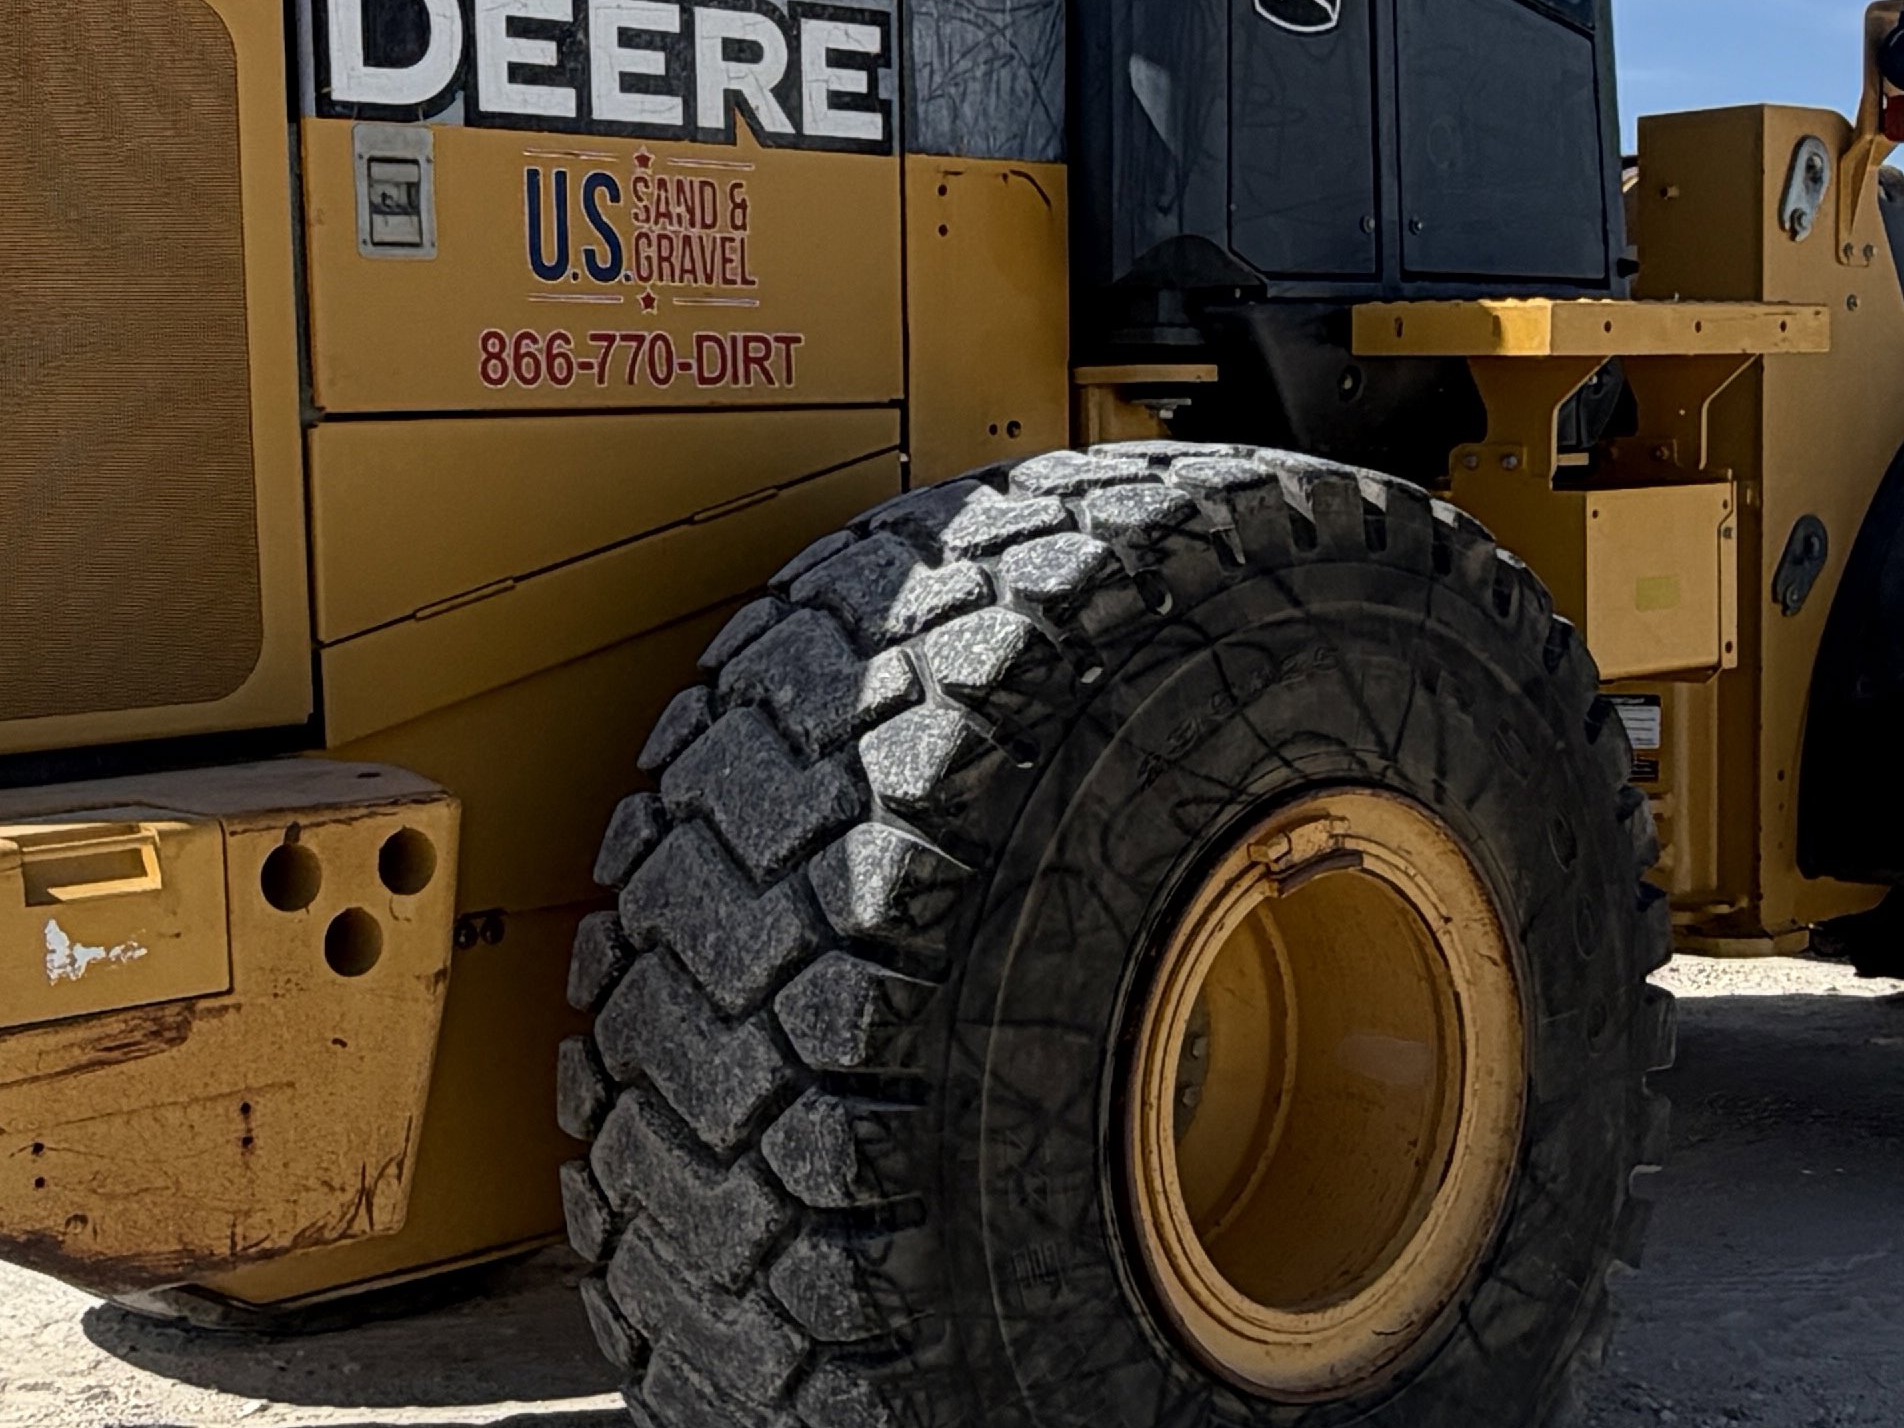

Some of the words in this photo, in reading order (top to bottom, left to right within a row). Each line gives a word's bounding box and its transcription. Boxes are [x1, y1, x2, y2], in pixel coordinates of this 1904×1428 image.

[525, 167, 632, 283] U.S.
[632, 175, 719, 231] SAND
[728, 181, 749, 231] &
[633, 231, 757, 286] GRAVEL
[479, 329, 804, 387] 866-770-DIRT
